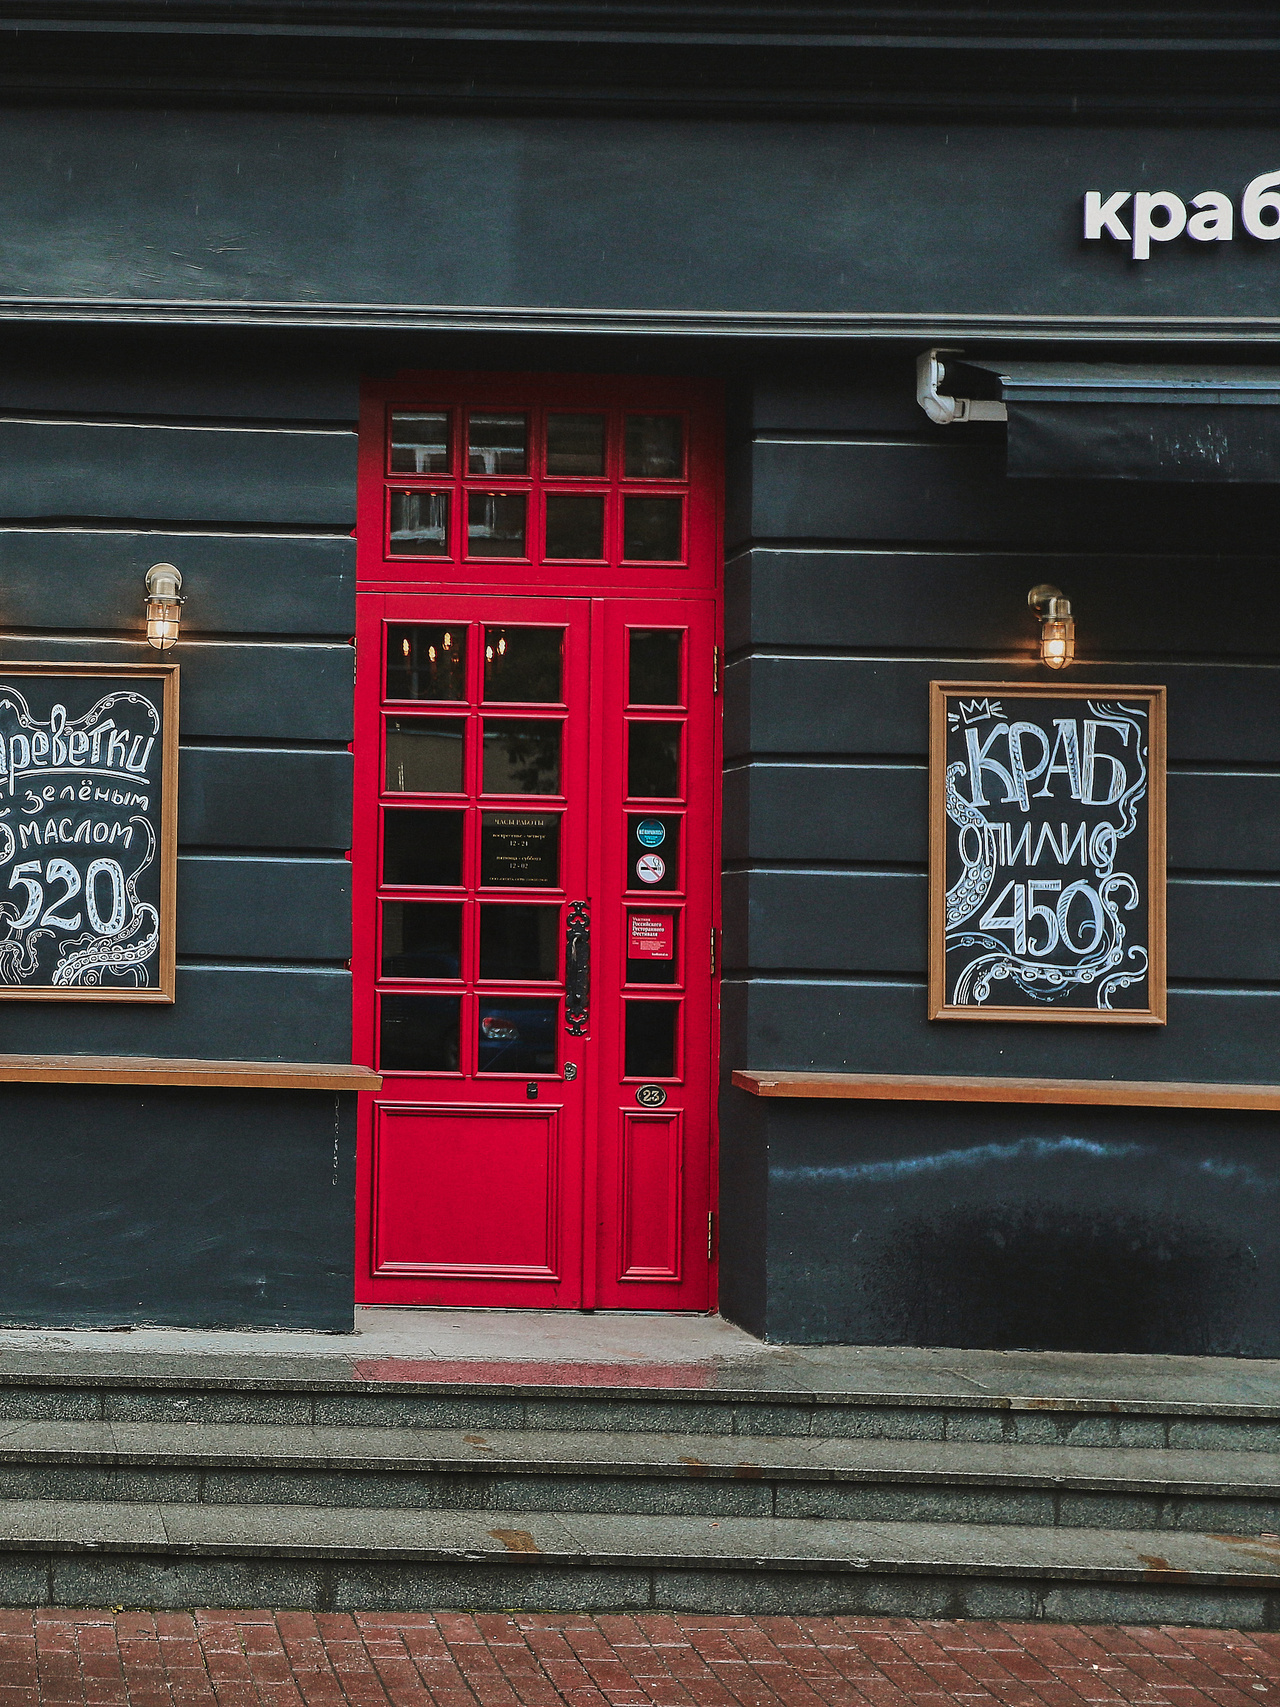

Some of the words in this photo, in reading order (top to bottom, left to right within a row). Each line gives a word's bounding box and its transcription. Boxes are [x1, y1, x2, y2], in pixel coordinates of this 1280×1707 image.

[1084, 169, 1280, 260] краб
[965, 718, 1130, 812] КРАБ
[6, 858, 125, 935] 520
[979, 879, 1104, 956] 450
[642, 1089, 660, 1102] 23
